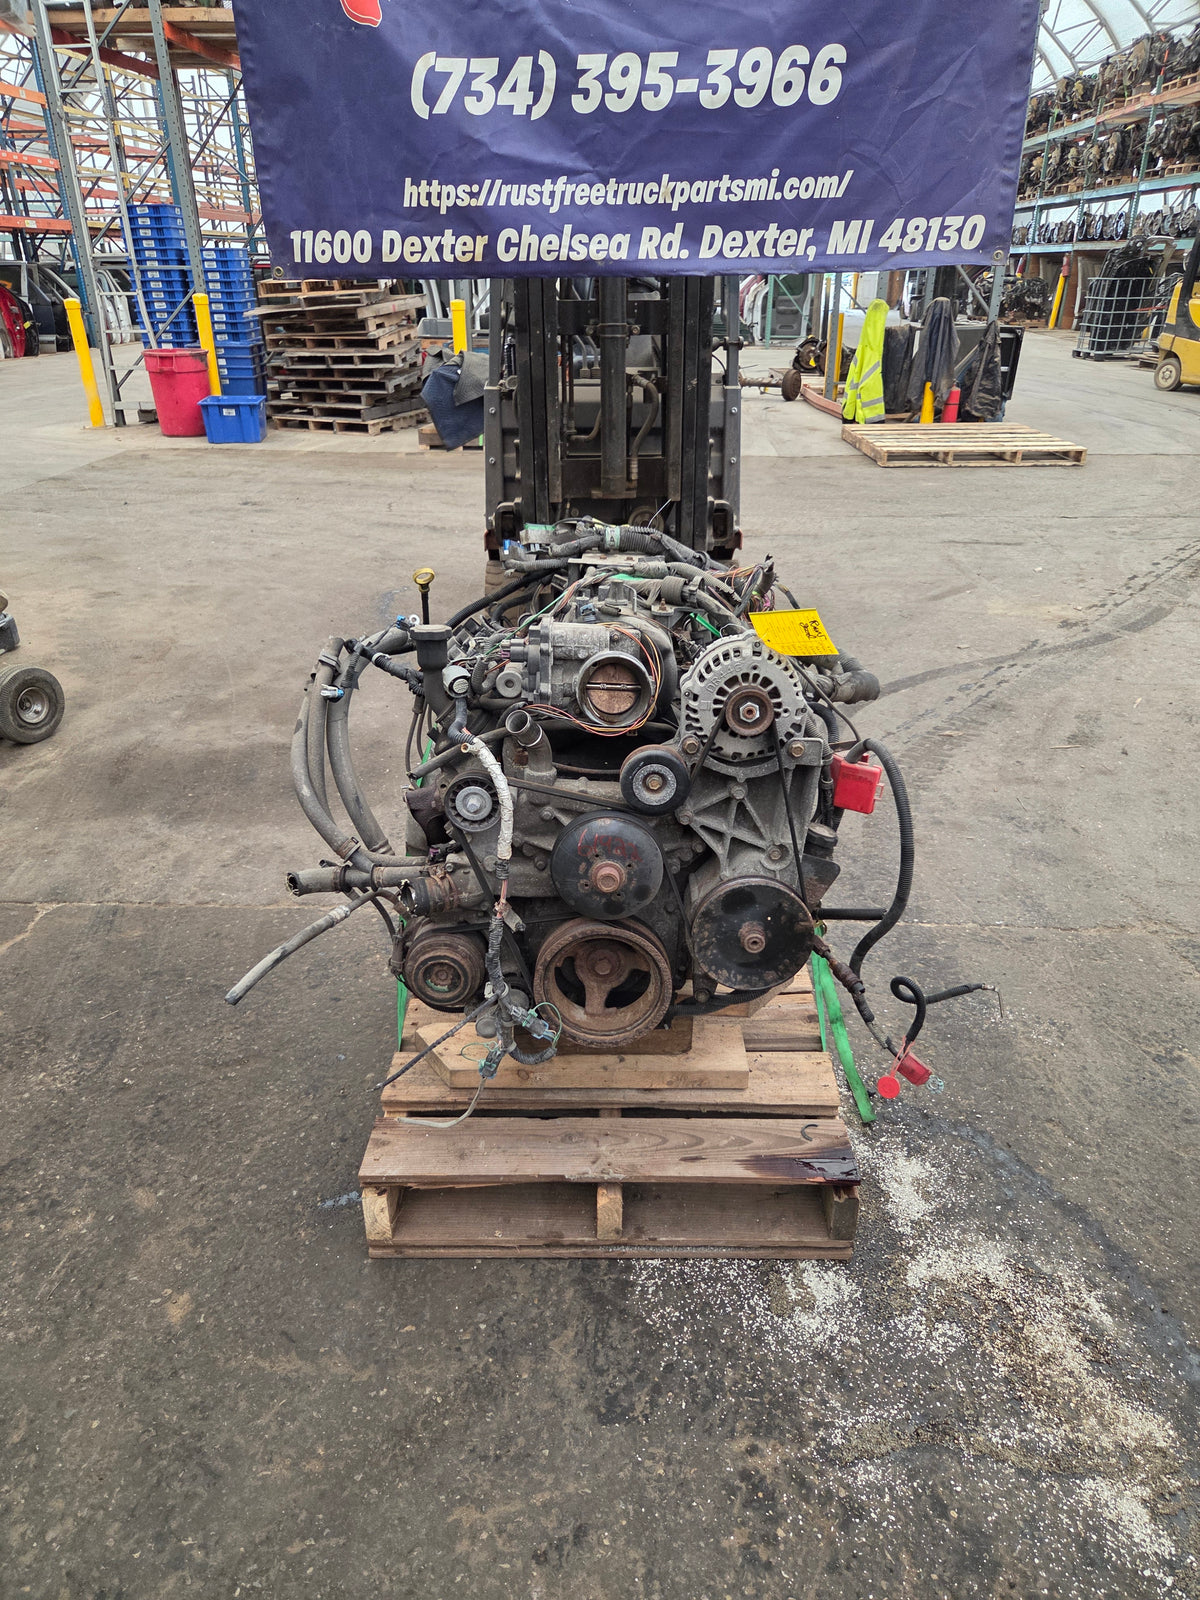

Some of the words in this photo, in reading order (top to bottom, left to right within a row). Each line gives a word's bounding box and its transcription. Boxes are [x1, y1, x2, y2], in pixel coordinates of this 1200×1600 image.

[411, 49, 557, 121] (734)
[571, 43, 847, 115] 395-3966
[403, 168, 854, 215] https://rustfreetruckpartsmi.com/
[290, 229, 372, 264] 11600
[382, 228, 489, 263] Dexter
[496, 224, 631, 262] Chelsea
[637, 222, 690, 260] Rd.
[699, 222, 817, 262] Dexter,
[827, 219, 875, 255] MI
[879, 214, 986, 253] 48130
